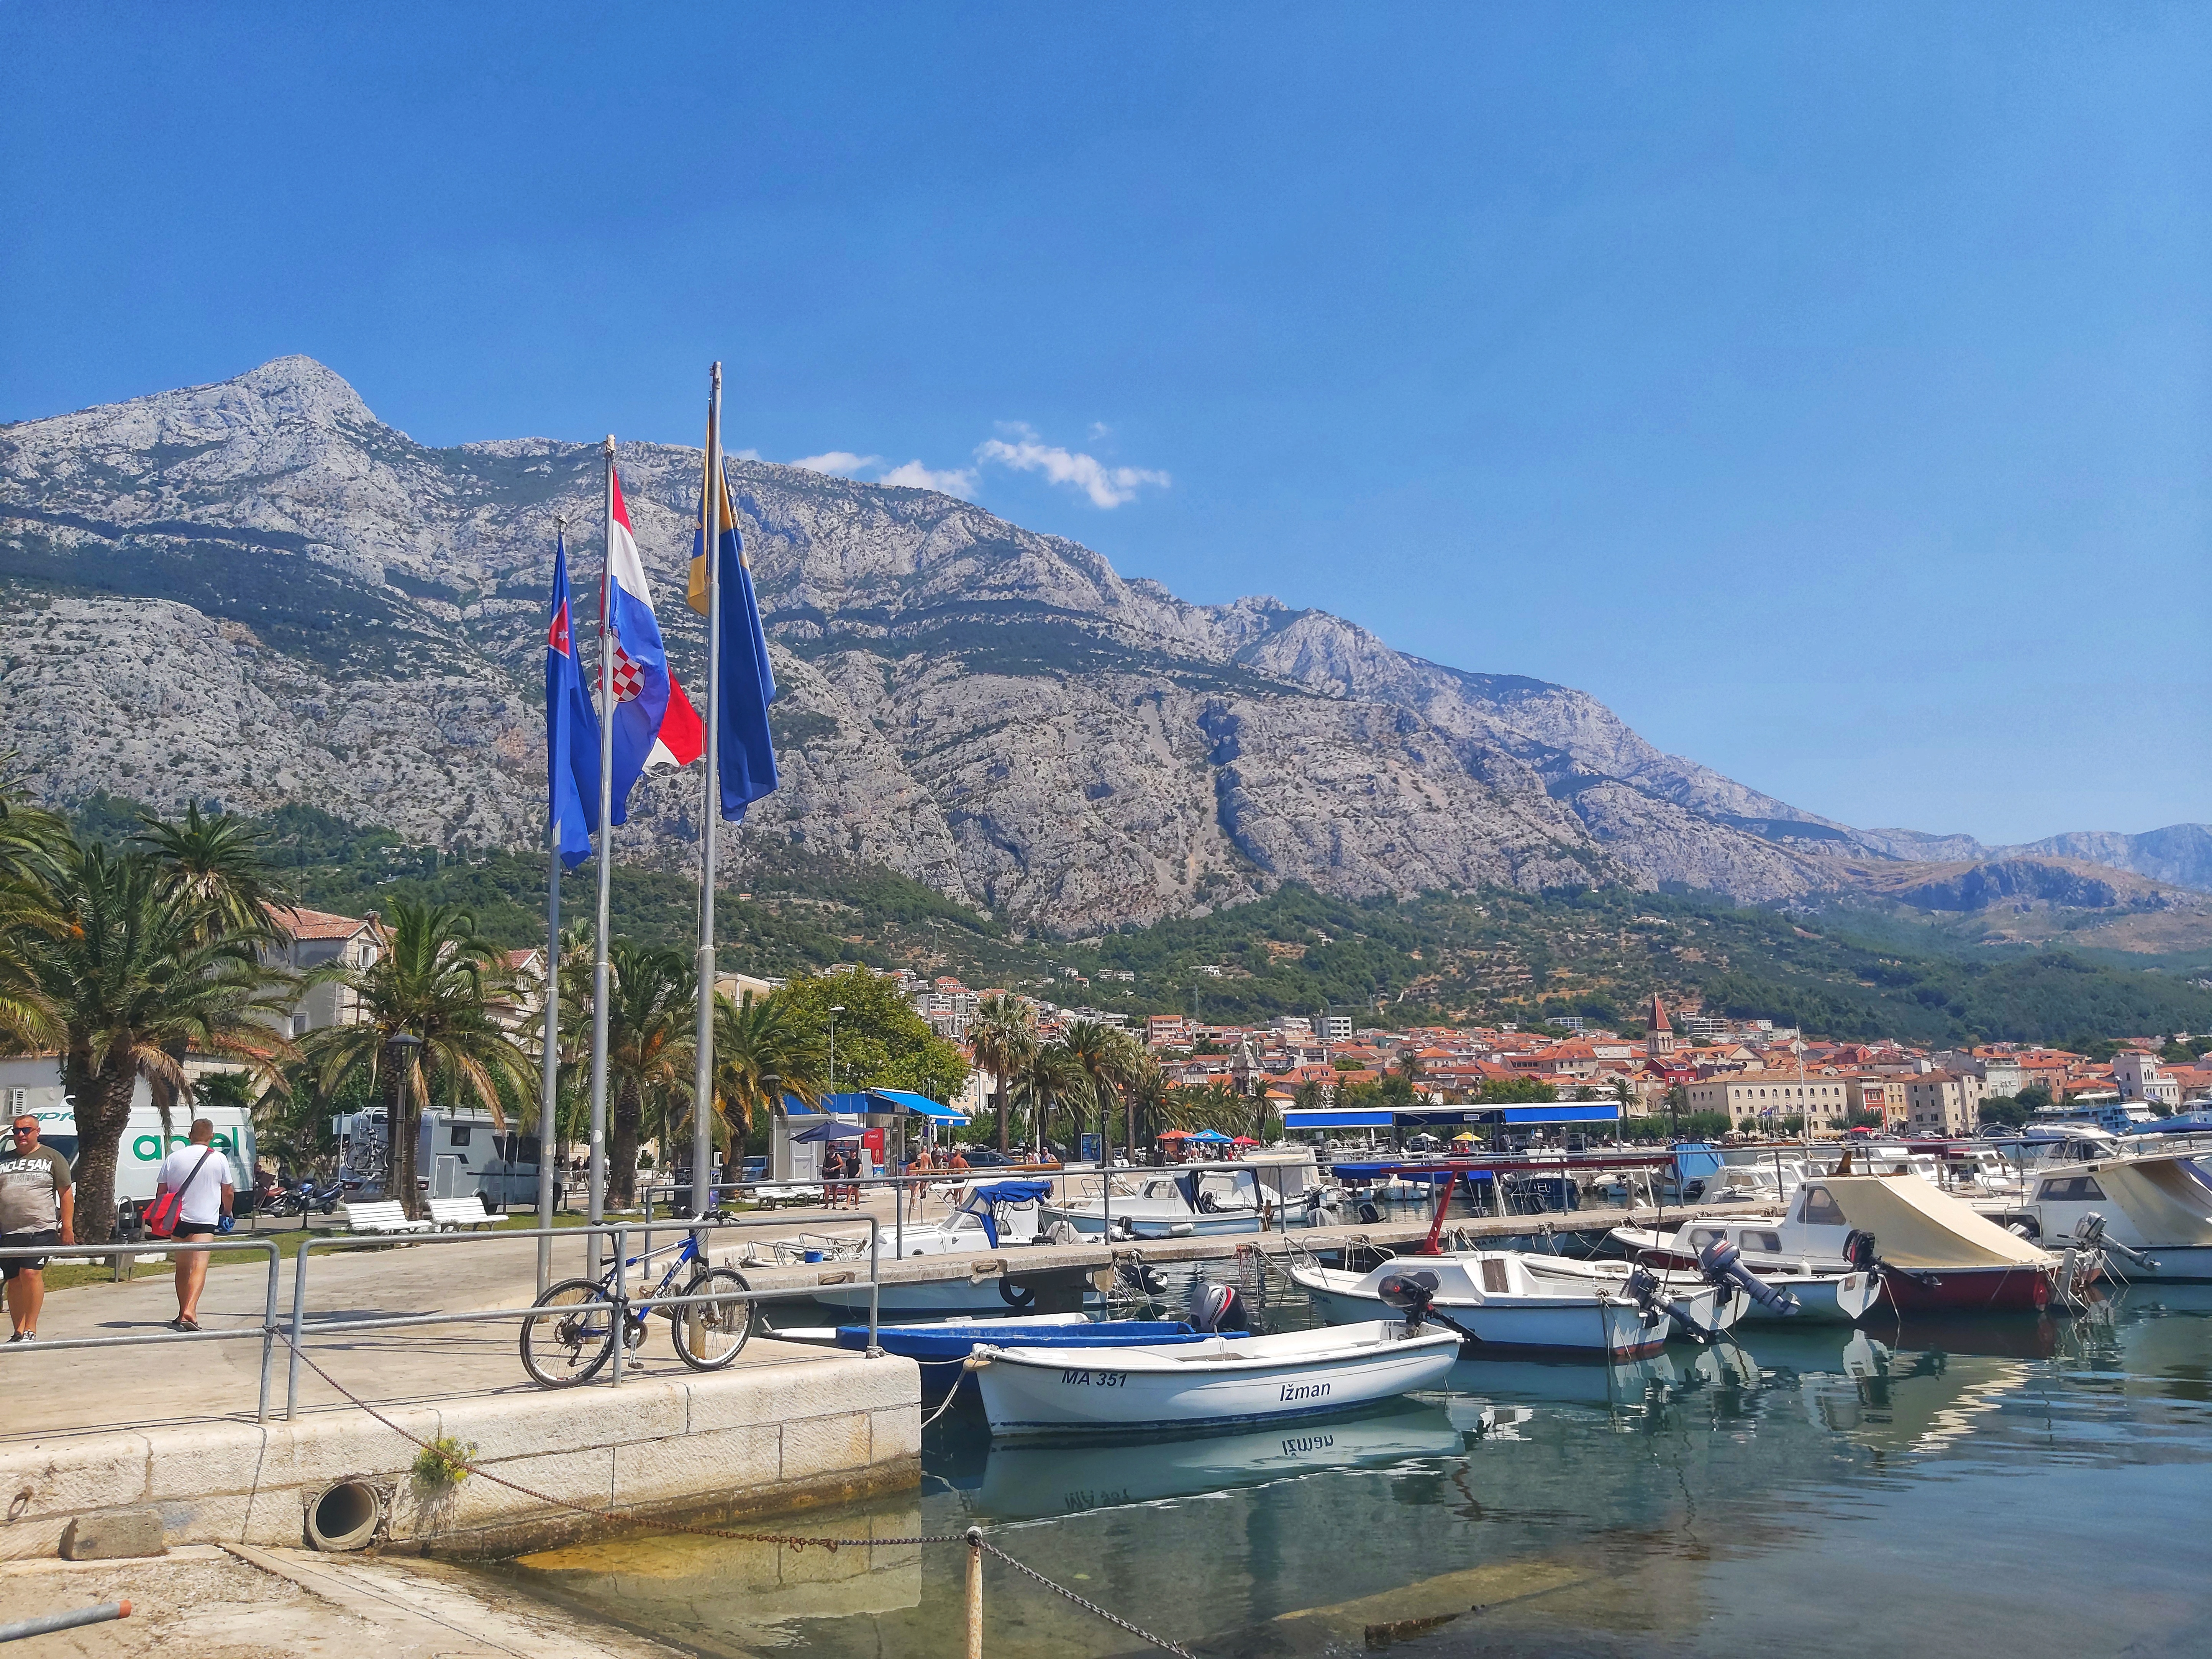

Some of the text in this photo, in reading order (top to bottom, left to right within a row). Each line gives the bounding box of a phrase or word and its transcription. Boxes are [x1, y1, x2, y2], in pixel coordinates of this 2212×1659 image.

[133, 1127, 240, 1161] apel
[0, 1159, 52, 1174] NCLE SAM
[8, 1173, 49, 1183] LIMITED
[1712, 1239, 1727, 1251] YAMAHA
[1208, 1291, 1224, 1325] MARINER
[1061, 1370, 1127, 1387] MA 351
[1280, 1383, 1331, 1402] Ižman
